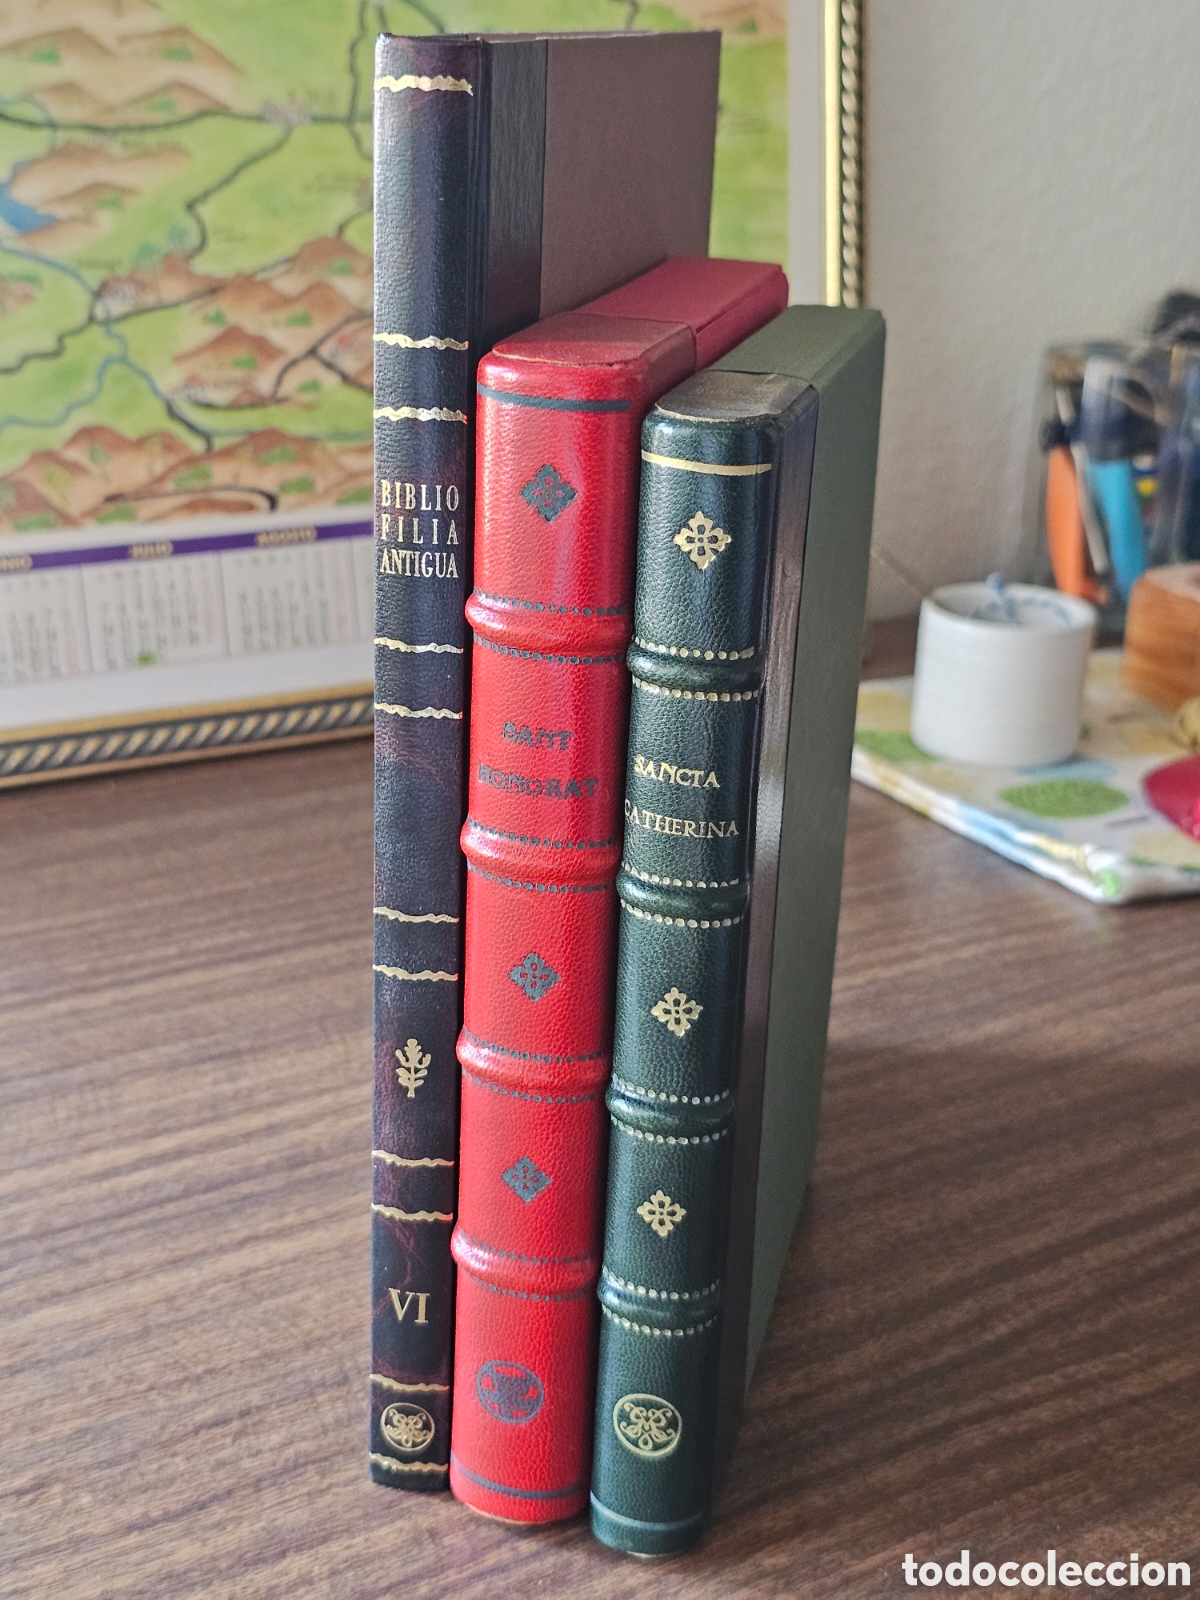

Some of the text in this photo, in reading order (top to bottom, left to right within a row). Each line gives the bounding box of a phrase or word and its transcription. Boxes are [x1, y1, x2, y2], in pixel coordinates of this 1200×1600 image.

[381, 480, 459, 511] BIBLIO
[381, 514, 459, 545] FILIA
[381, 547, 459, 578] ANTIGUA
[503, 721, 573, 750] SANT
[478, 763, 598, 799] HONORAT
[634, 754, 720, 788] SANCTA
[625, 799, 739, 838] CATHERINA
[388, 1287, 430, 1323] VI
